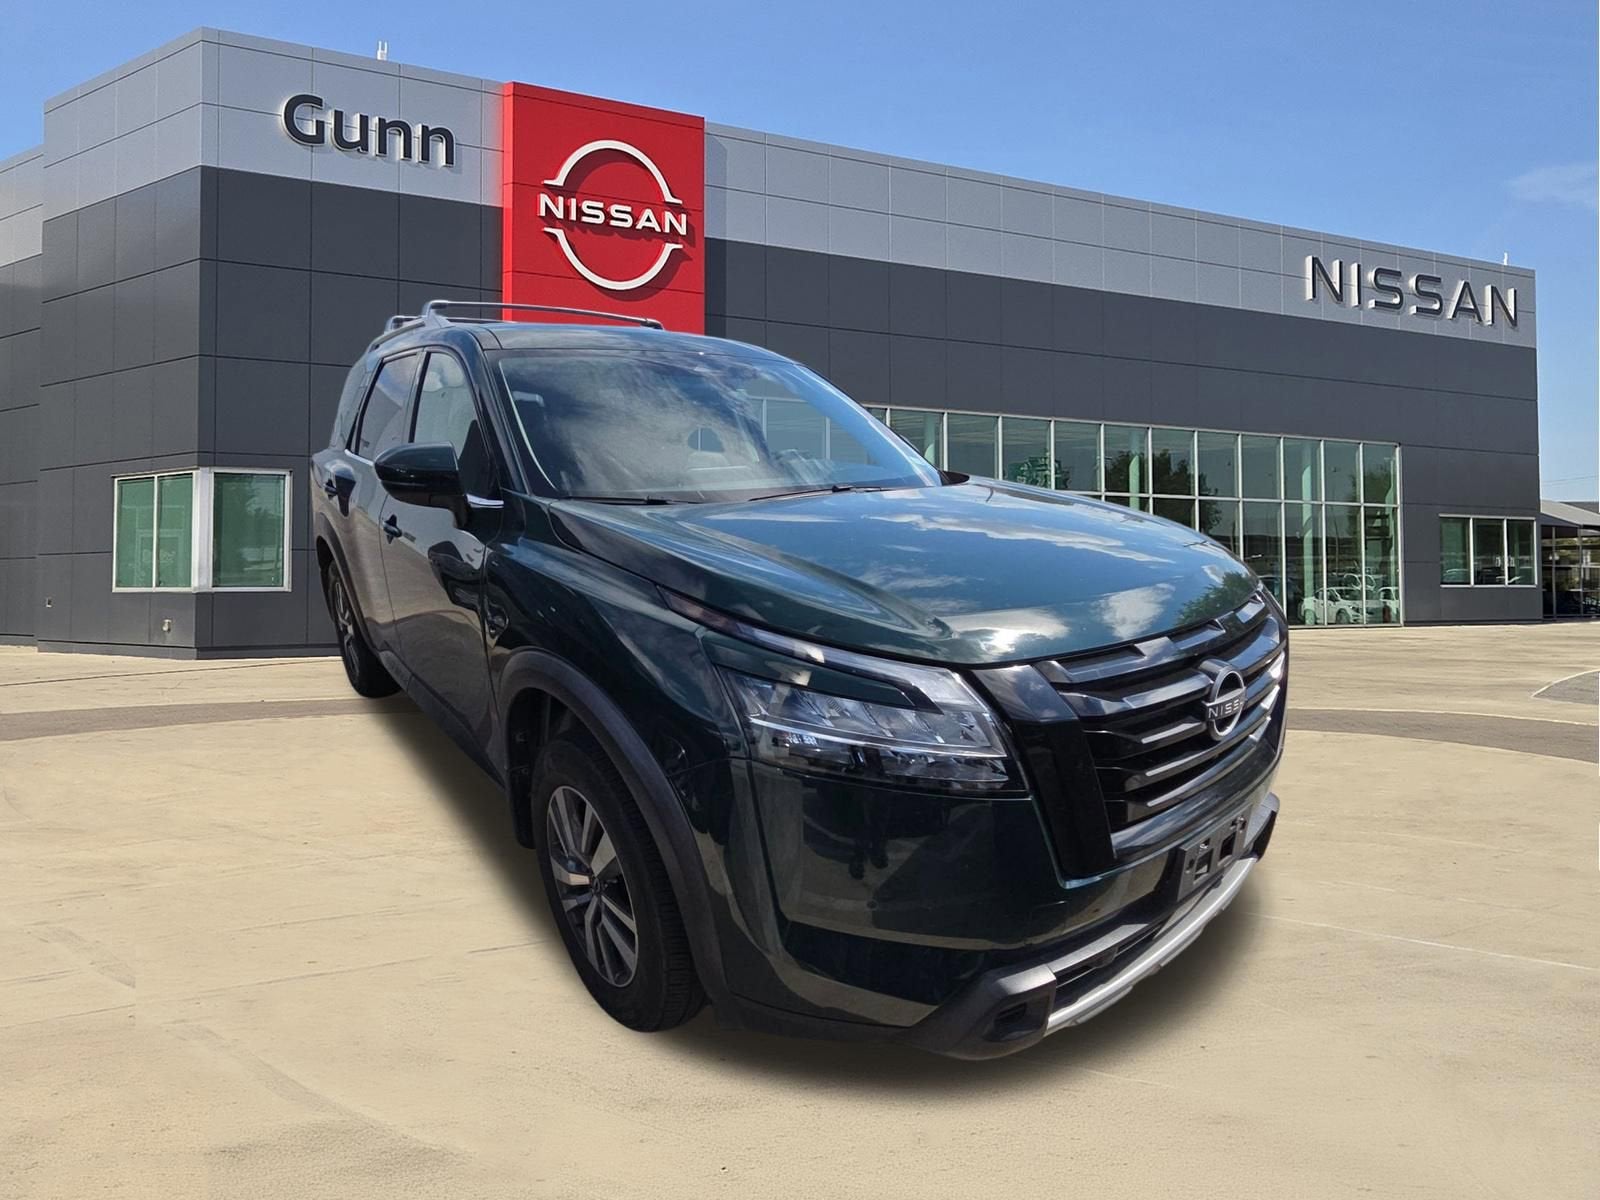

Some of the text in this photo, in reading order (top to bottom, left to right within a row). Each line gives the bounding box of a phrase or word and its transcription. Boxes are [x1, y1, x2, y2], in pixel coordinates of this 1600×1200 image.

[282, 94, 455, 167] Gunn
[538, 193, 688, 236] NISSAN
[1305, 255, 1518, 328] NISSAN
[1208, 699, 1242, 719] NISS
